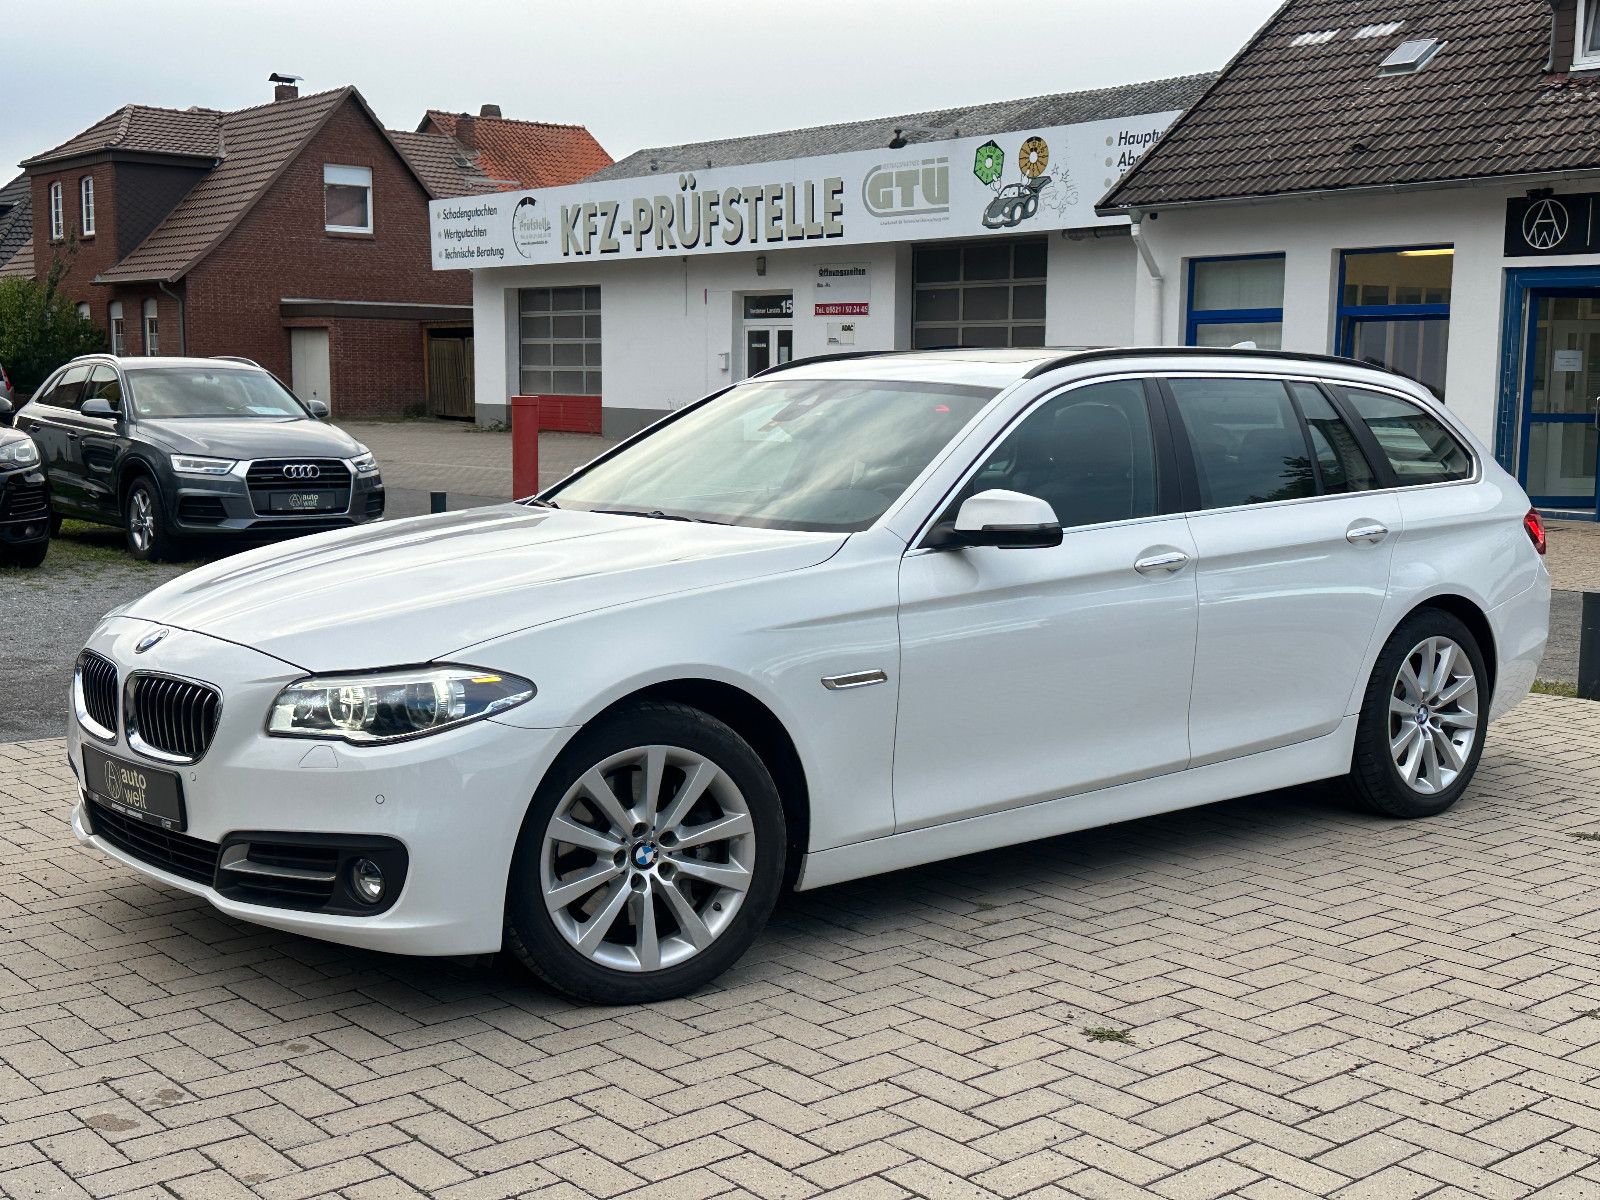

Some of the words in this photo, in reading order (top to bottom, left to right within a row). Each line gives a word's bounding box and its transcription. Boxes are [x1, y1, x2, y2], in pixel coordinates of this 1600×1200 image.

[867, 156, 950, 210] GTÜ
[443, 204, 498, 221] Schadengutachten
[561, 173, 844, 257] KFZ-PRÜFSTELLE
[443, 226, 487, 241] Wertgutachten
[444, 246, 475, 259] Technische
[477, 246, 504, 260] Beratung
[781, 299, 793, 314] 15
[120, 768, 147, 790] auto
[123, 787, 147, 809] welt
